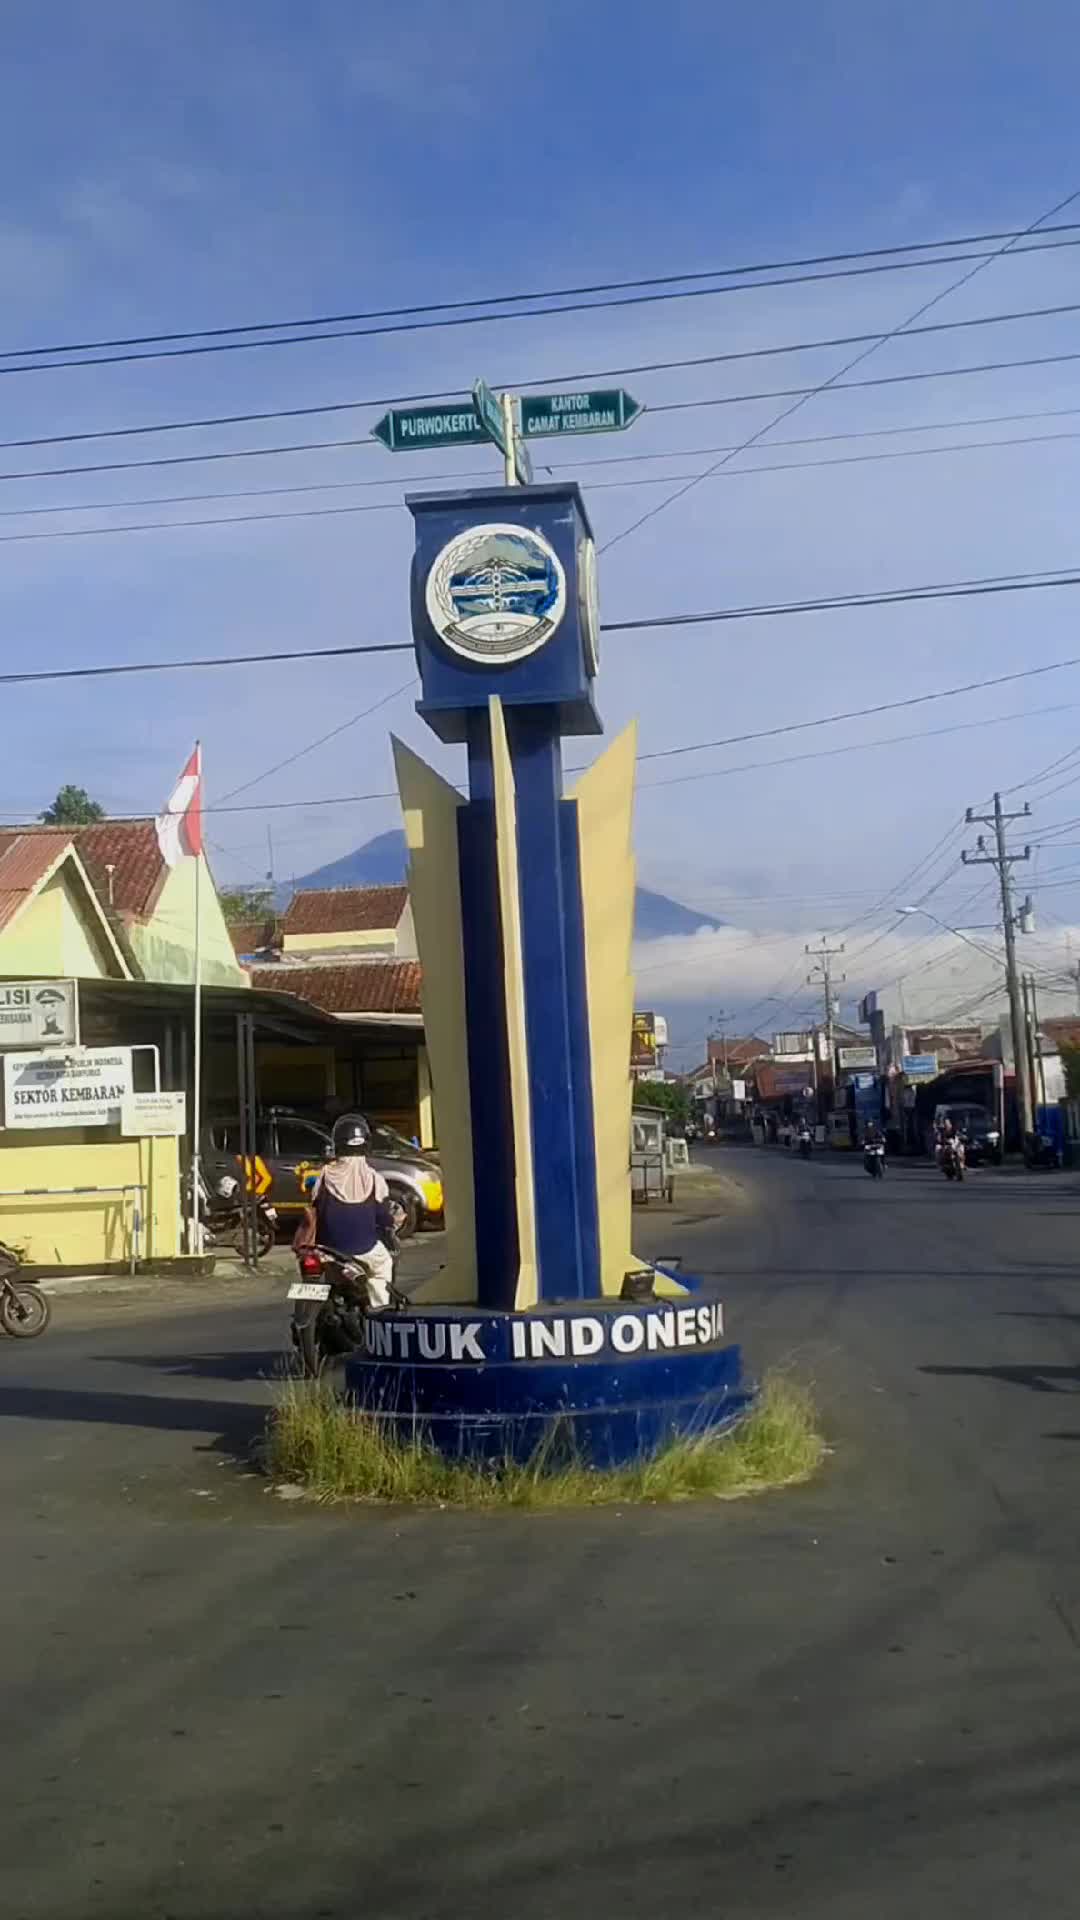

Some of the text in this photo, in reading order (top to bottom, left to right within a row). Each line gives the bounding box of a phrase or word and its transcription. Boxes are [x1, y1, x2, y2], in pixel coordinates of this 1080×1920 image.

[551, 394, 590, 412] KANTOR
[527, 415, 560, 433] CAMAT
[14, 1085, 125, 1105] SEKTOR KEMBARAN
[365, 1303, 724, 1360] UNTUK INDONESIA
